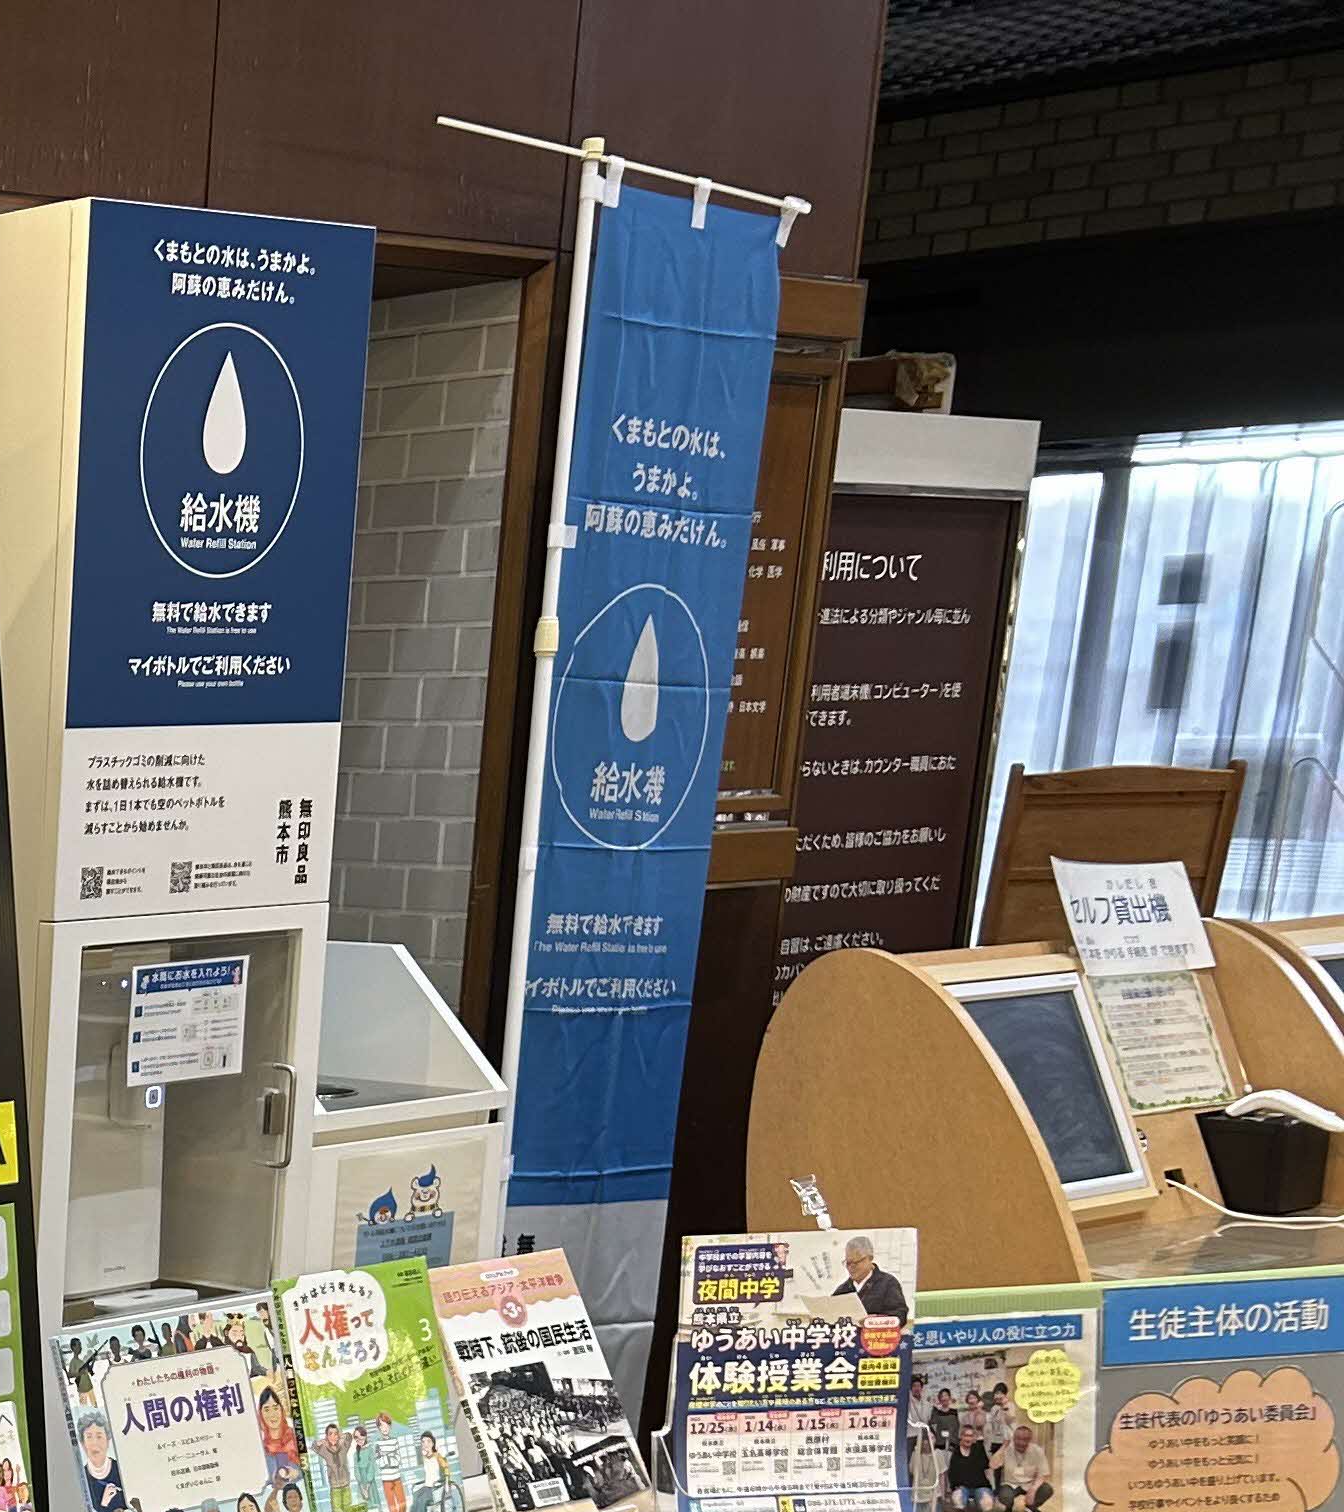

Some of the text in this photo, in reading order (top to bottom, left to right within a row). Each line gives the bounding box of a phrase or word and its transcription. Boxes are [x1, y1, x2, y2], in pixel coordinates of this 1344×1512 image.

[152, 238, 317, 276] くまもとの水は、うまかよ。
[170, 272, 296, 306] 阿蘇の恵みだけん。
[611, 412, 727, 461] くまもとの水は、
[631, 461, 701, 502] うまかよ。
[178, 491, 261, 535] 給水機
[583, 502, 728, 551] 阿蘇の恵みだけん。
[180, 537, 204, 549] Water
[228, 538, 258, 551] Station
[151, 601, 273, 624] 無料で給水できます
[127, 654, 292, 677] マイボトルでご利用ください
[589, 760, 666, 806] 給水機
[275, 799, 293, 866] 熊本市
[293, 798, 314, 885] 無印良品
[1069, 894, 1172, 926] セルフ貸出機
[697, 1277, 781, 1302] 夜間中学
[298, 1303, 375, 1346] 人権って
[417, 1317, 433, 1343] 3
[690, 1322, 859, 1353] ゆうあい中学校
[1128, 1297, 1329, 1342] 生徒主体の活動
[687, 1355, 857, 1397] 体験授業会
[121, 1382, 246, 1436] 人間の権利
